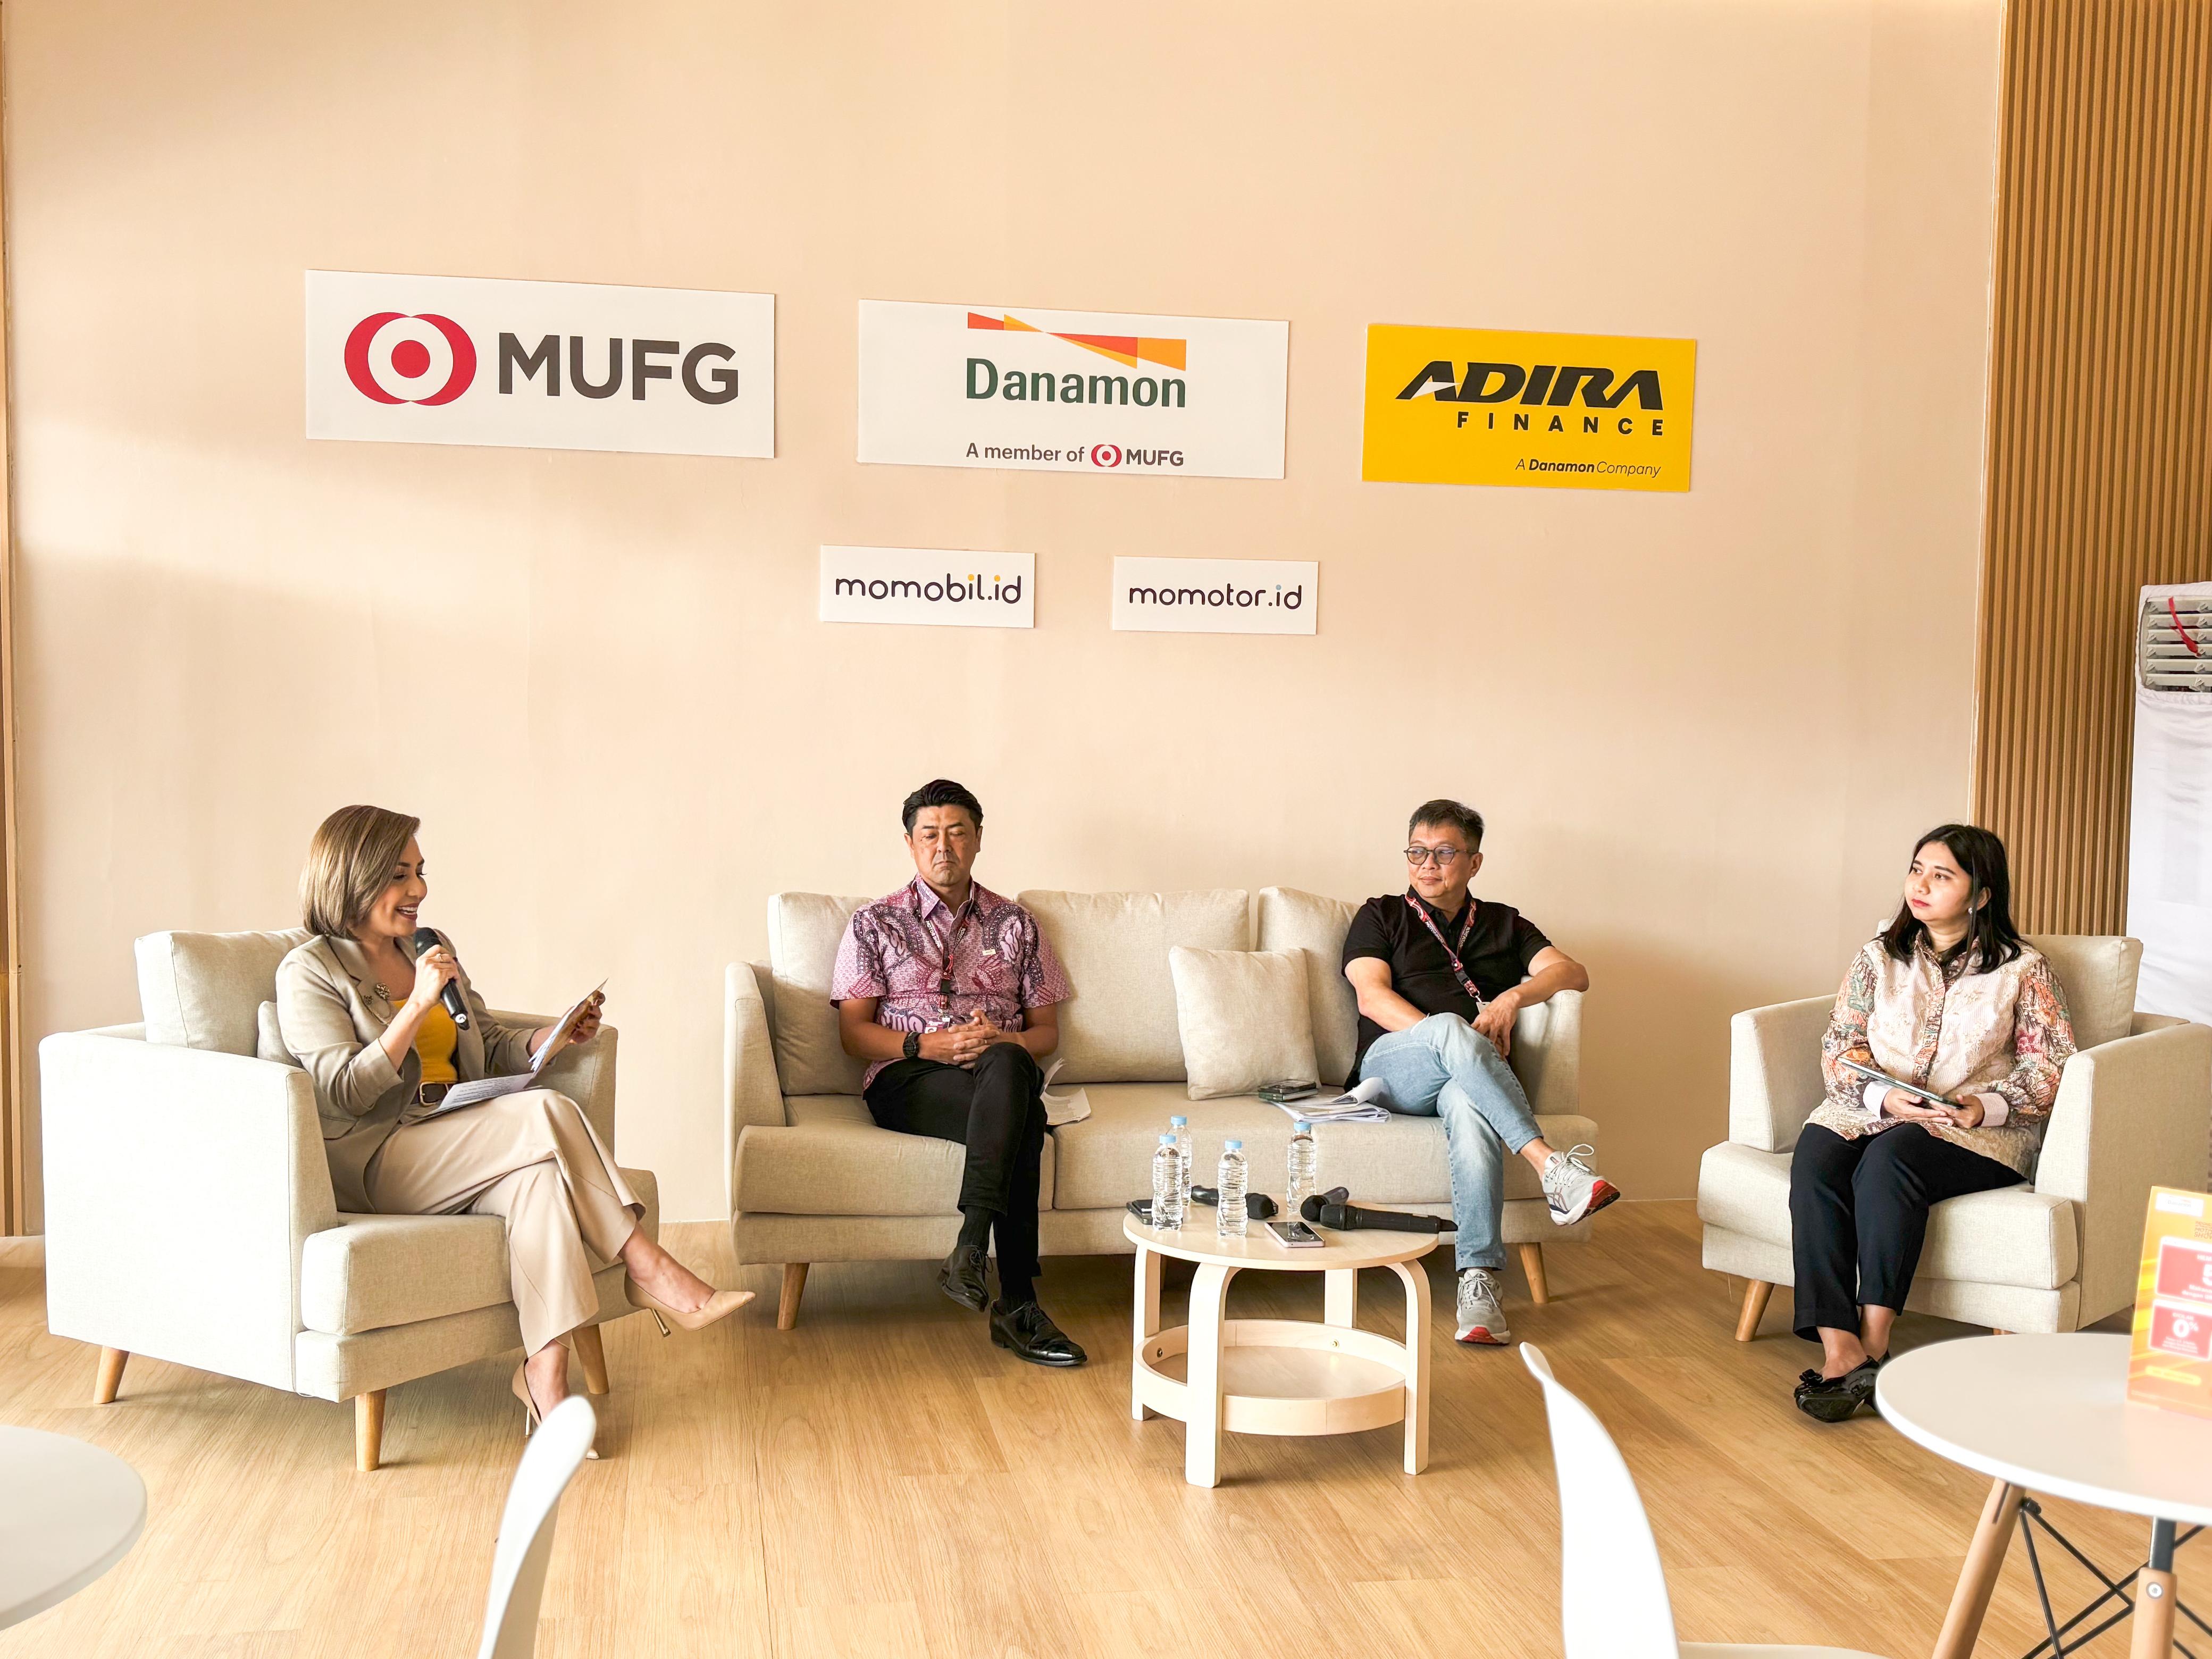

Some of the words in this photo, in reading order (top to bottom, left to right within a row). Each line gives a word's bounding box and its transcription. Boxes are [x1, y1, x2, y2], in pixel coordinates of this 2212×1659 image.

[499, 332, 739, 405] MUFG
[966, 357, 1186, 408] Danamon
[1395, 361, 1663, 410] ADIRA
[1457, 411, 1663, 436] FINANCE
[966, 442, 979, 458] A
[985, 444, 1061, 462] member
[1066, 446, 1085, 463] of
[1126, 448, 1184, 467] MUFG
[1515, 458, 1526, 471] A
[1529, 458, 1595, 473] Danamon
[1596, 461, 1662, 478] Company
[835, 573, 1021, 604] momobil.id
[1129, 583, 1302, 610] momotor.id
